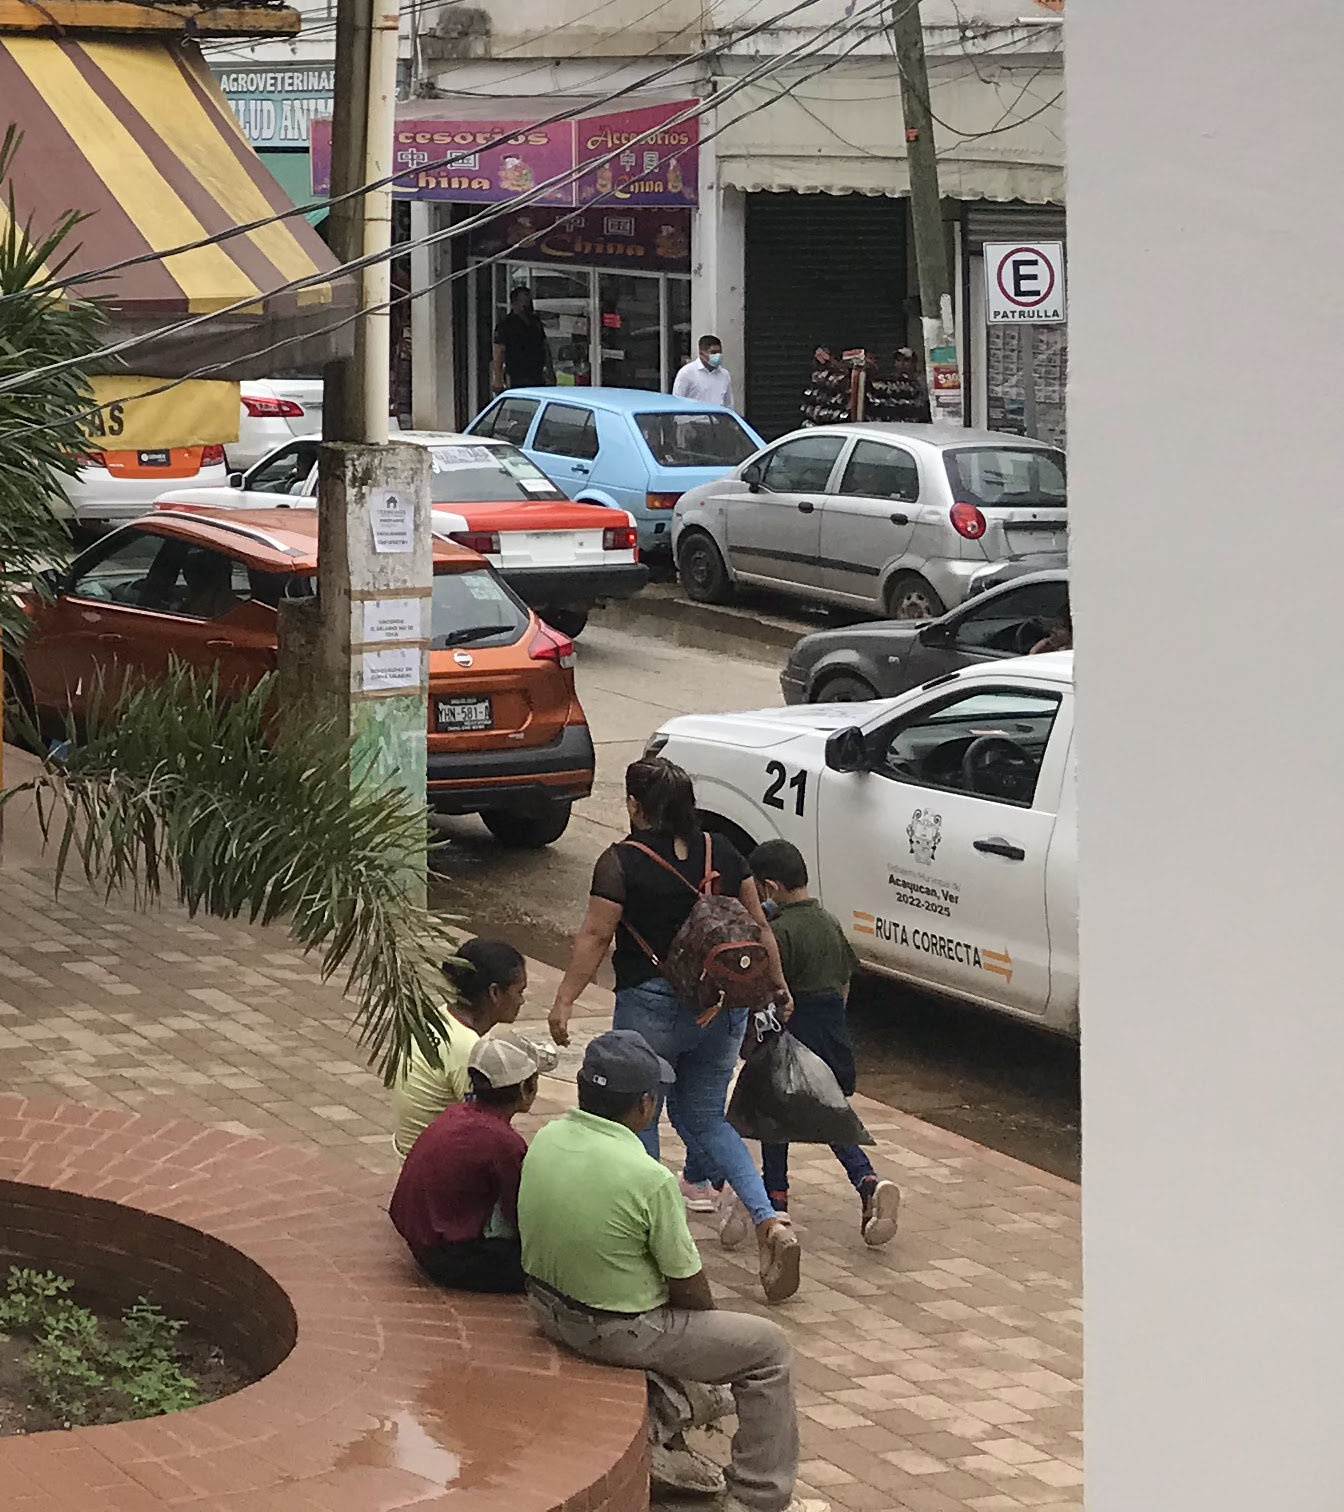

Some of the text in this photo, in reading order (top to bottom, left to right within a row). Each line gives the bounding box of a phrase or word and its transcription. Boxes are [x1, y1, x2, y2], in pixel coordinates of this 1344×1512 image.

[1012, 259, 1041, 297] E
[993, 309, 1060, 320] PATRULLA
[762, 760, 809, 817] 21
[896, 892, 952, 918] 2022-2025
[941, 889, 960, 905] Ver
[875, 916, 983, 970] RUTA CORRECTA
